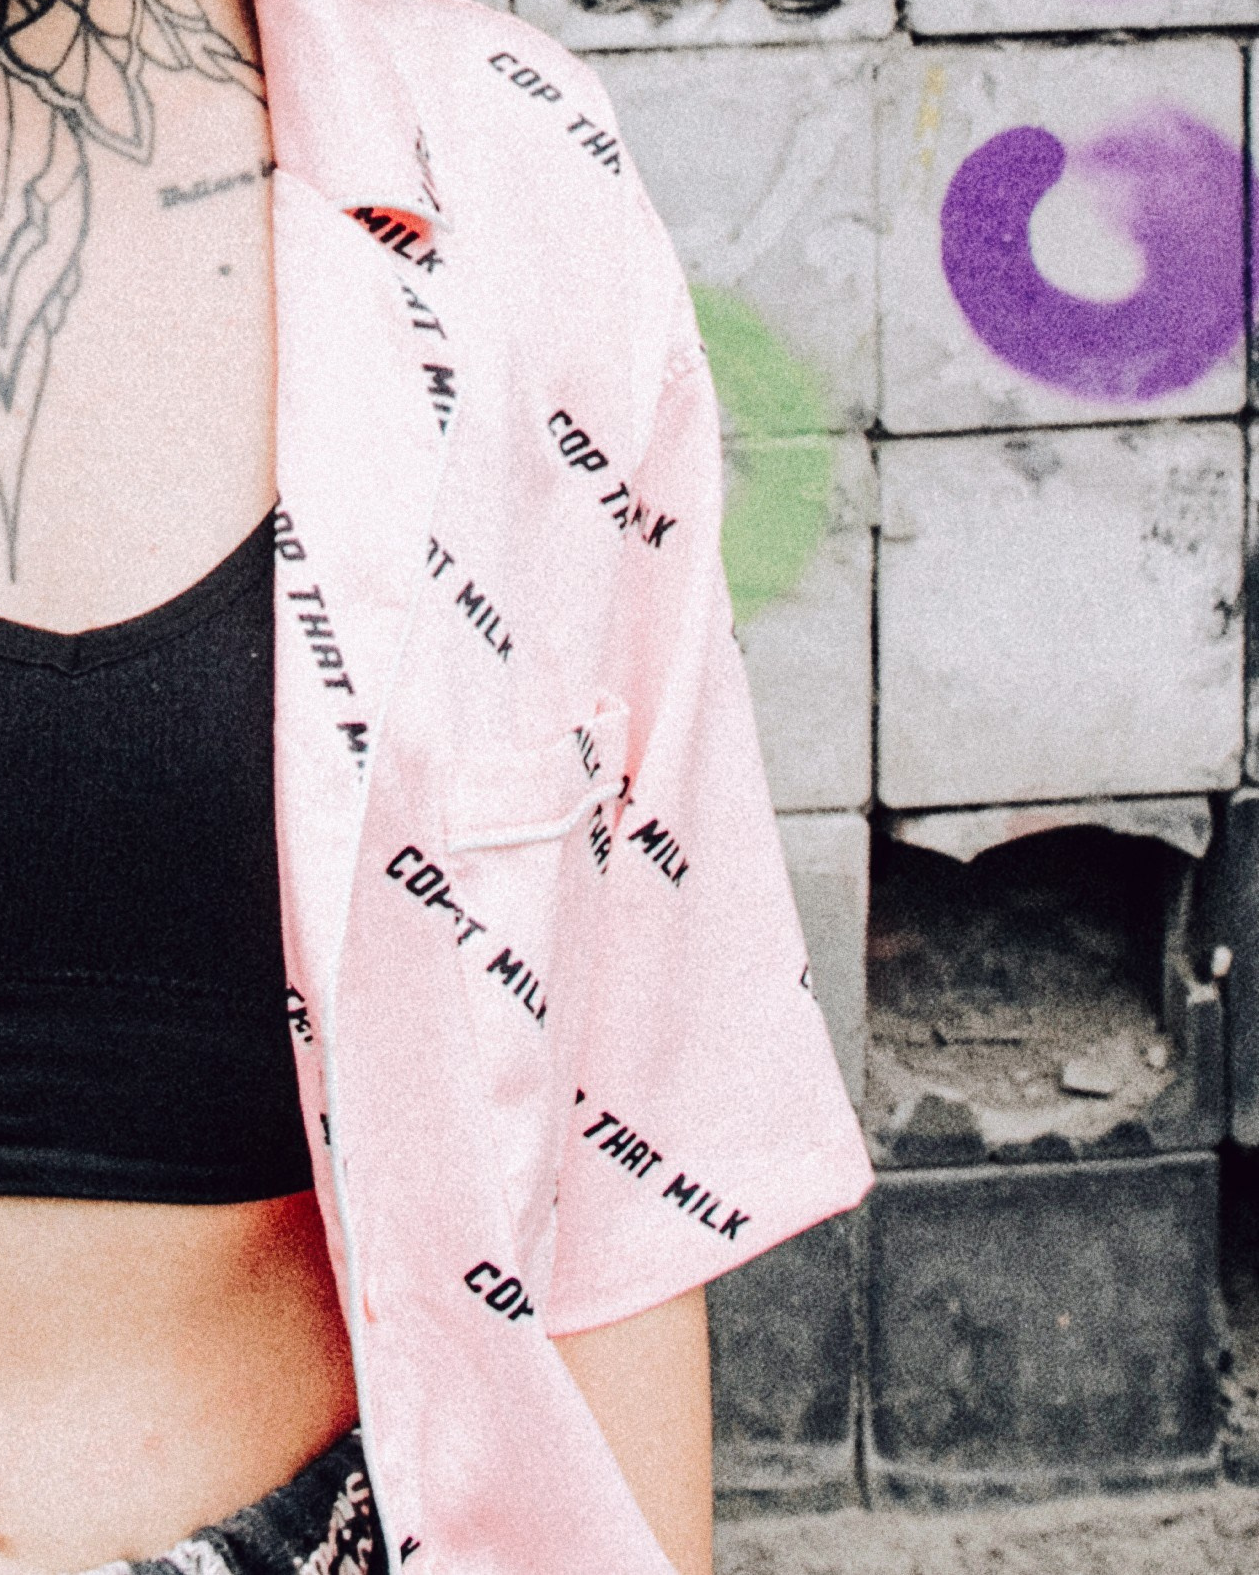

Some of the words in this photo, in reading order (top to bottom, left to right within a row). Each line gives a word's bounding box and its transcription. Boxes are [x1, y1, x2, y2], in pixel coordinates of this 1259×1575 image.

[488, 51, 562, 103] COP
[353, 207, 443, 274] MILK
[549, 409, 609, 472] COP
[287, 584, 355, 696] THAT
[455, 580, 513, 663] MILK
[628, 818, 689, 888] MILK
[583, 1111, 663, 1178] THAT
[662, 1173, 752, 1240] MILK
